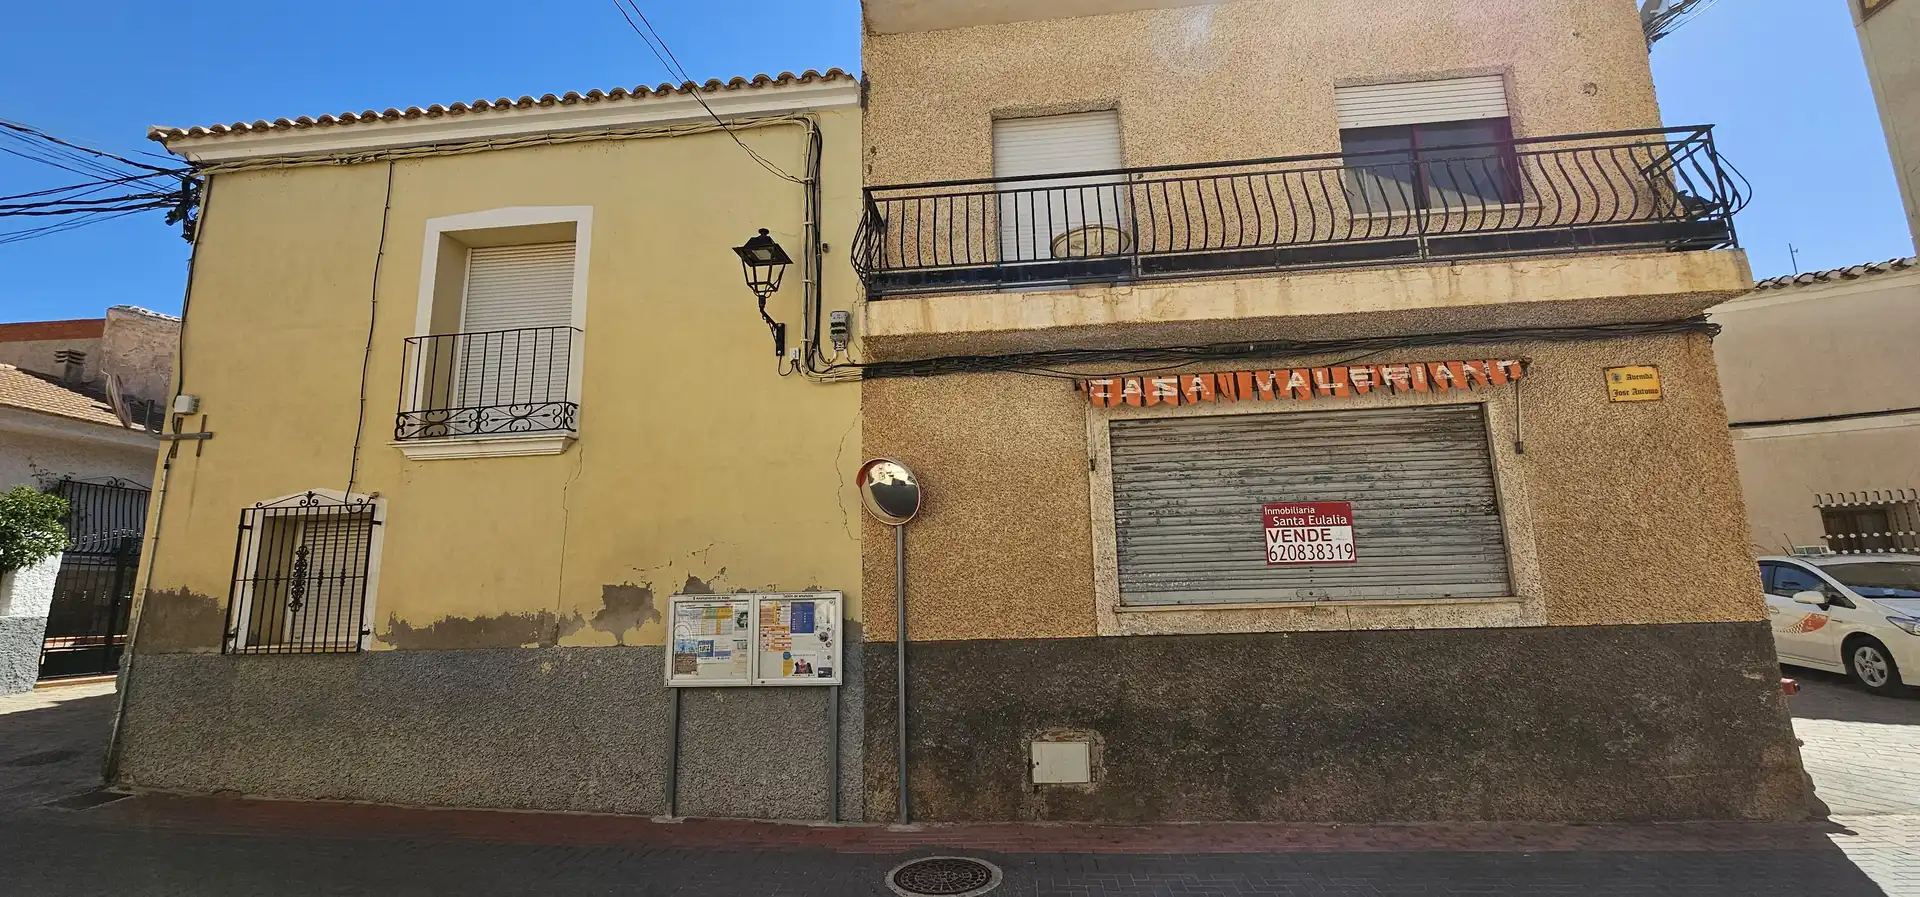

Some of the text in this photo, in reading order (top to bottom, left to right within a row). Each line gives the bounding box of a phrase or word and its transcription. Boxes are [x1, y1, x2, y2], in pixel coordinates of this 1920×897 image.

[1089, 376, 1211, 398] CASA
[1264, 506, 1316, 515] Inmobiliaria
[1272, 514, 1348, 526] Santa Eulalia
[1267, 528, 1333, 543] VENDE
[1269, 543, 1354, 562] 620838319
